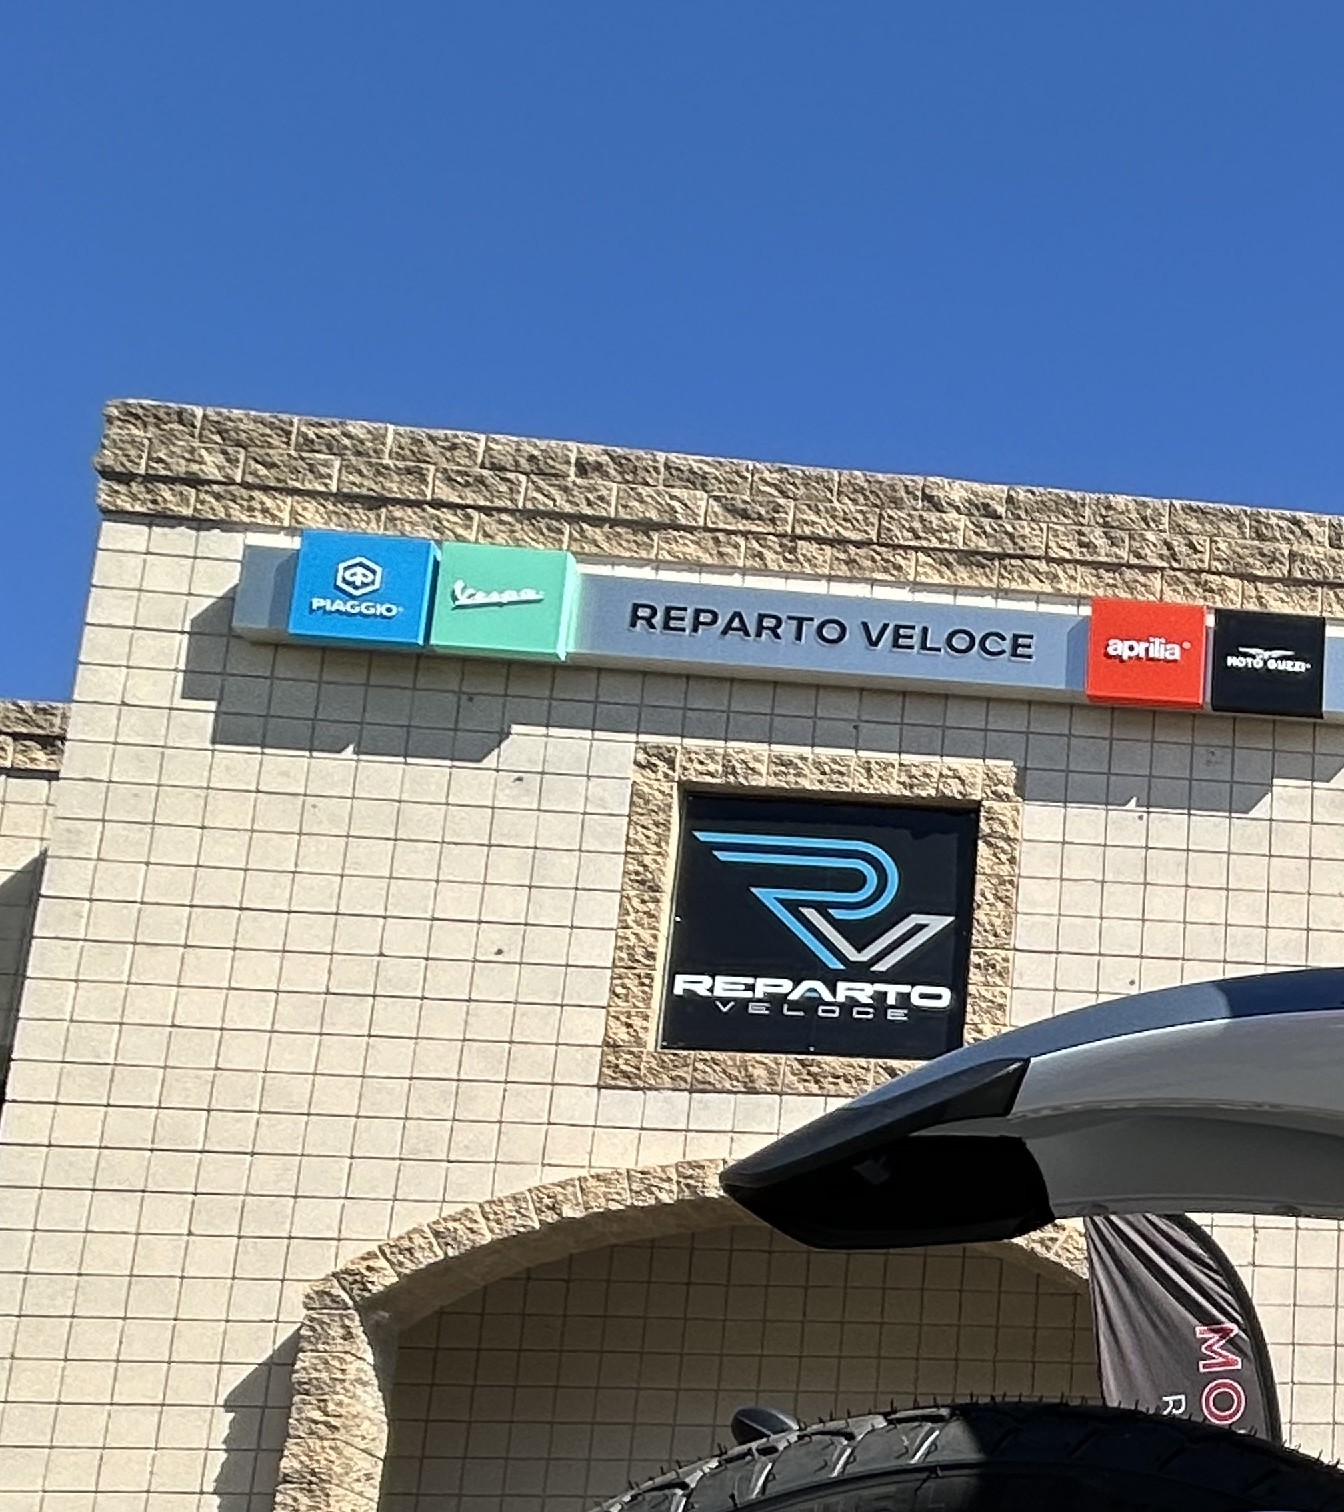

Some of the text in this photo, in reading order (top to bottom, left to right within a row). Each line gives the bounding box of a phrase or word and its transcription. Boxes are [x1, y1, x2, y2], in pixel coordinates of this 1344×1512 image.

[453, 580, 540, 606] Vespa
[311, 597, 398, 617] PIAGGIO
[628, 602, 1035, 661] REPARTO VELOCE
[1106, 637, 1181, 661] aprilia
[1226, 655, 1307, 673] MOTO GUZZI
[672, 972, 952, 1010] REPARTO
[713, 1002, 910, 1022] VELOCE
